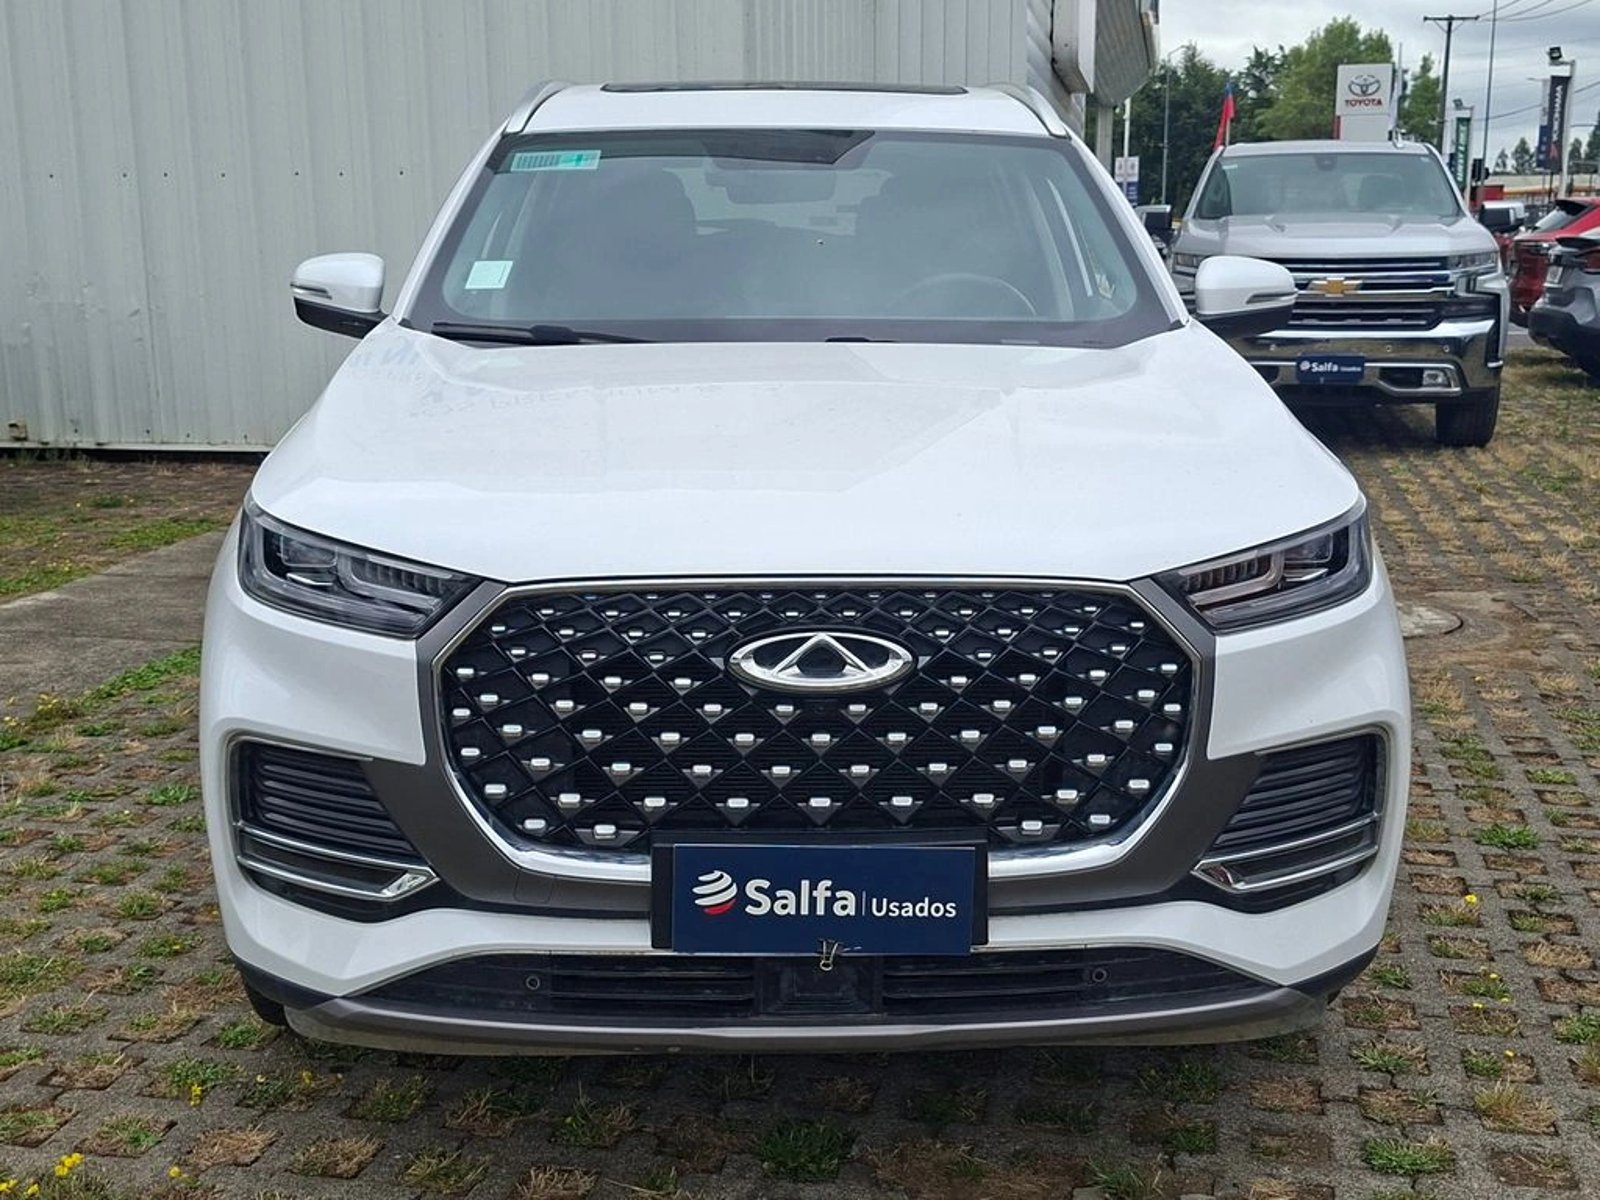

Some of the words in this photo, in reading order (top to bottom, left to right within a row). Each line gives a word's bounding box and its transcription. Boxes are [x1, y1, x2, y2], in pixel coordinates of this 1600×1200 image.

[1345, 98, 1382, 107] TOYOTA
[1311, 361, 1338, 372] Salfa
[745, 879, 856, 917] Salfa
[871, 897, 957, 918] Usados
